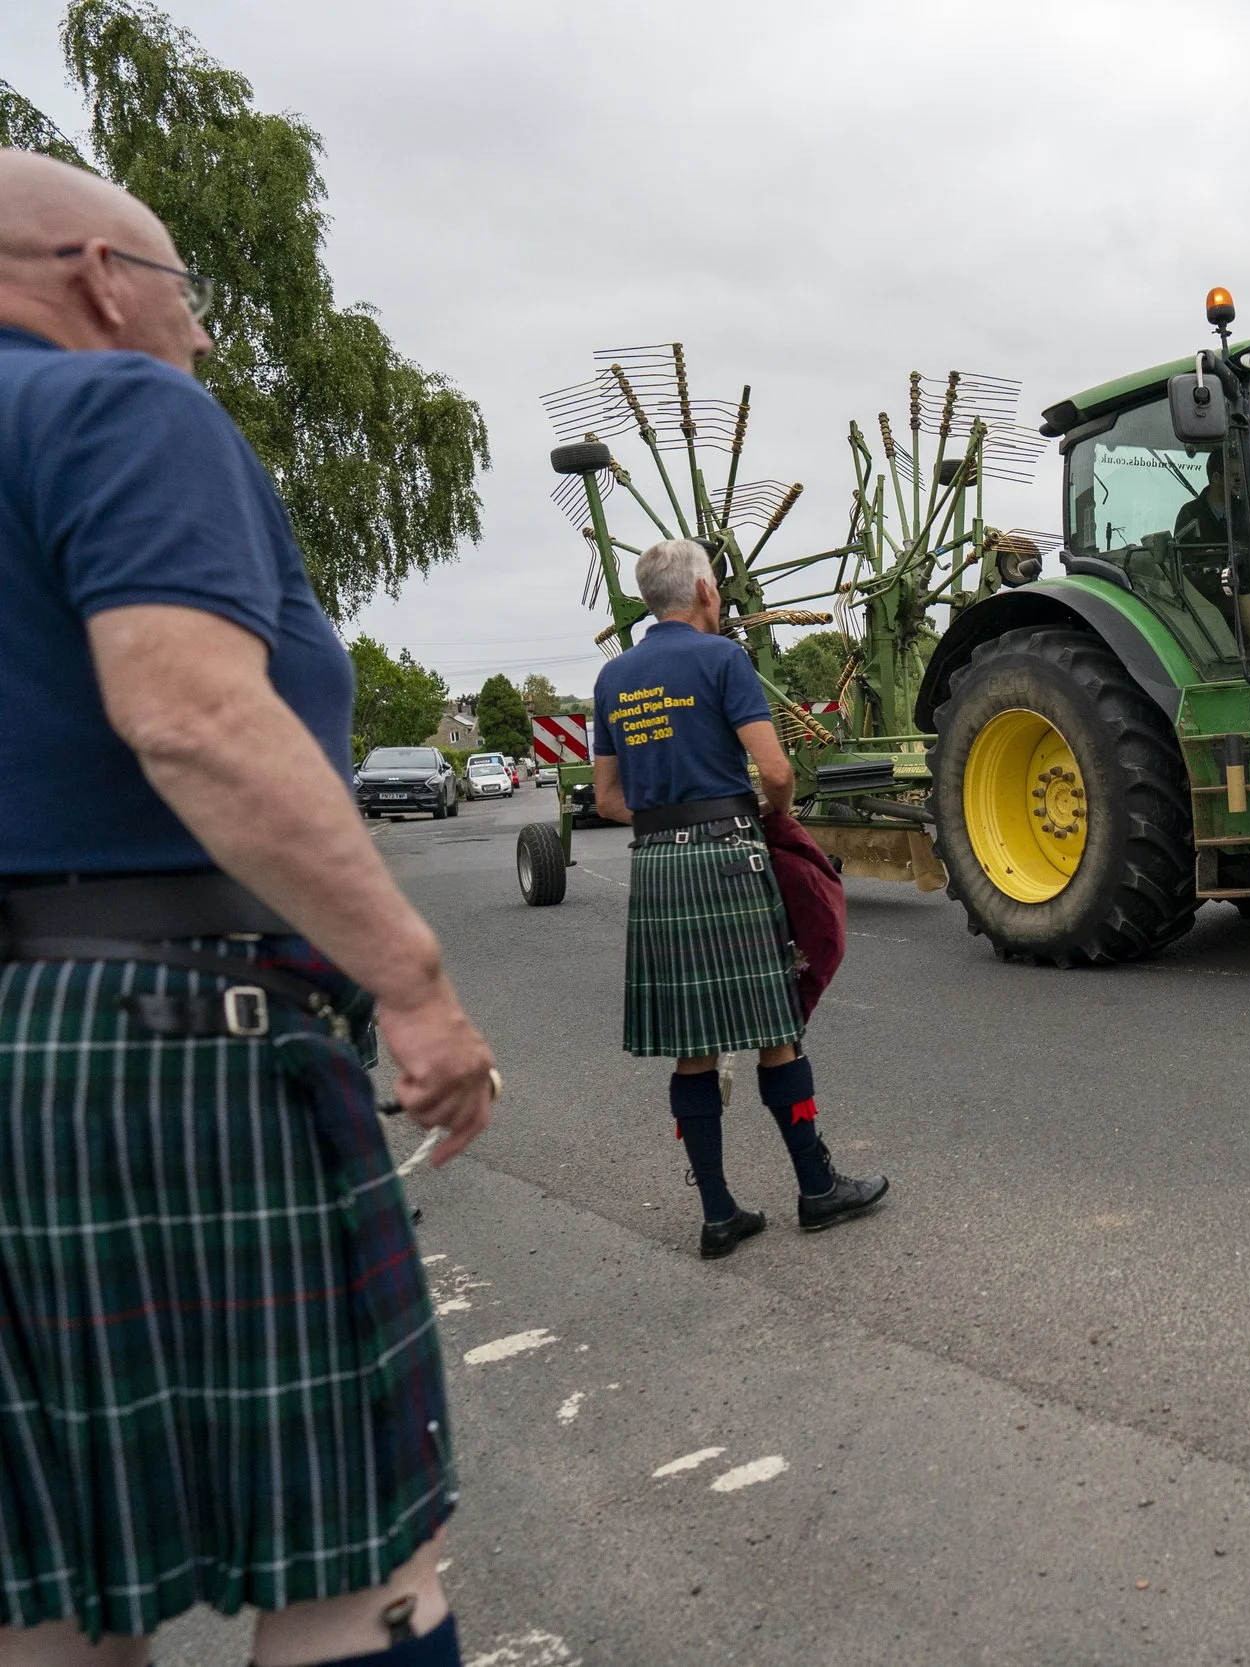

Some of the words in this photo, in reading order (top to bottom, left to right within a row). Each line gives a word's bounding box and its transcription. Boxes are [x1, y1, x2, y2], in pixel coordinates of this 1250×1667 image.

[619, 686, 664, 703] Rothbury
[643, 701, 663, 713] Pipe
[664, 696, 694, 708] Band
[623, 715, 669, 732] Centenary
